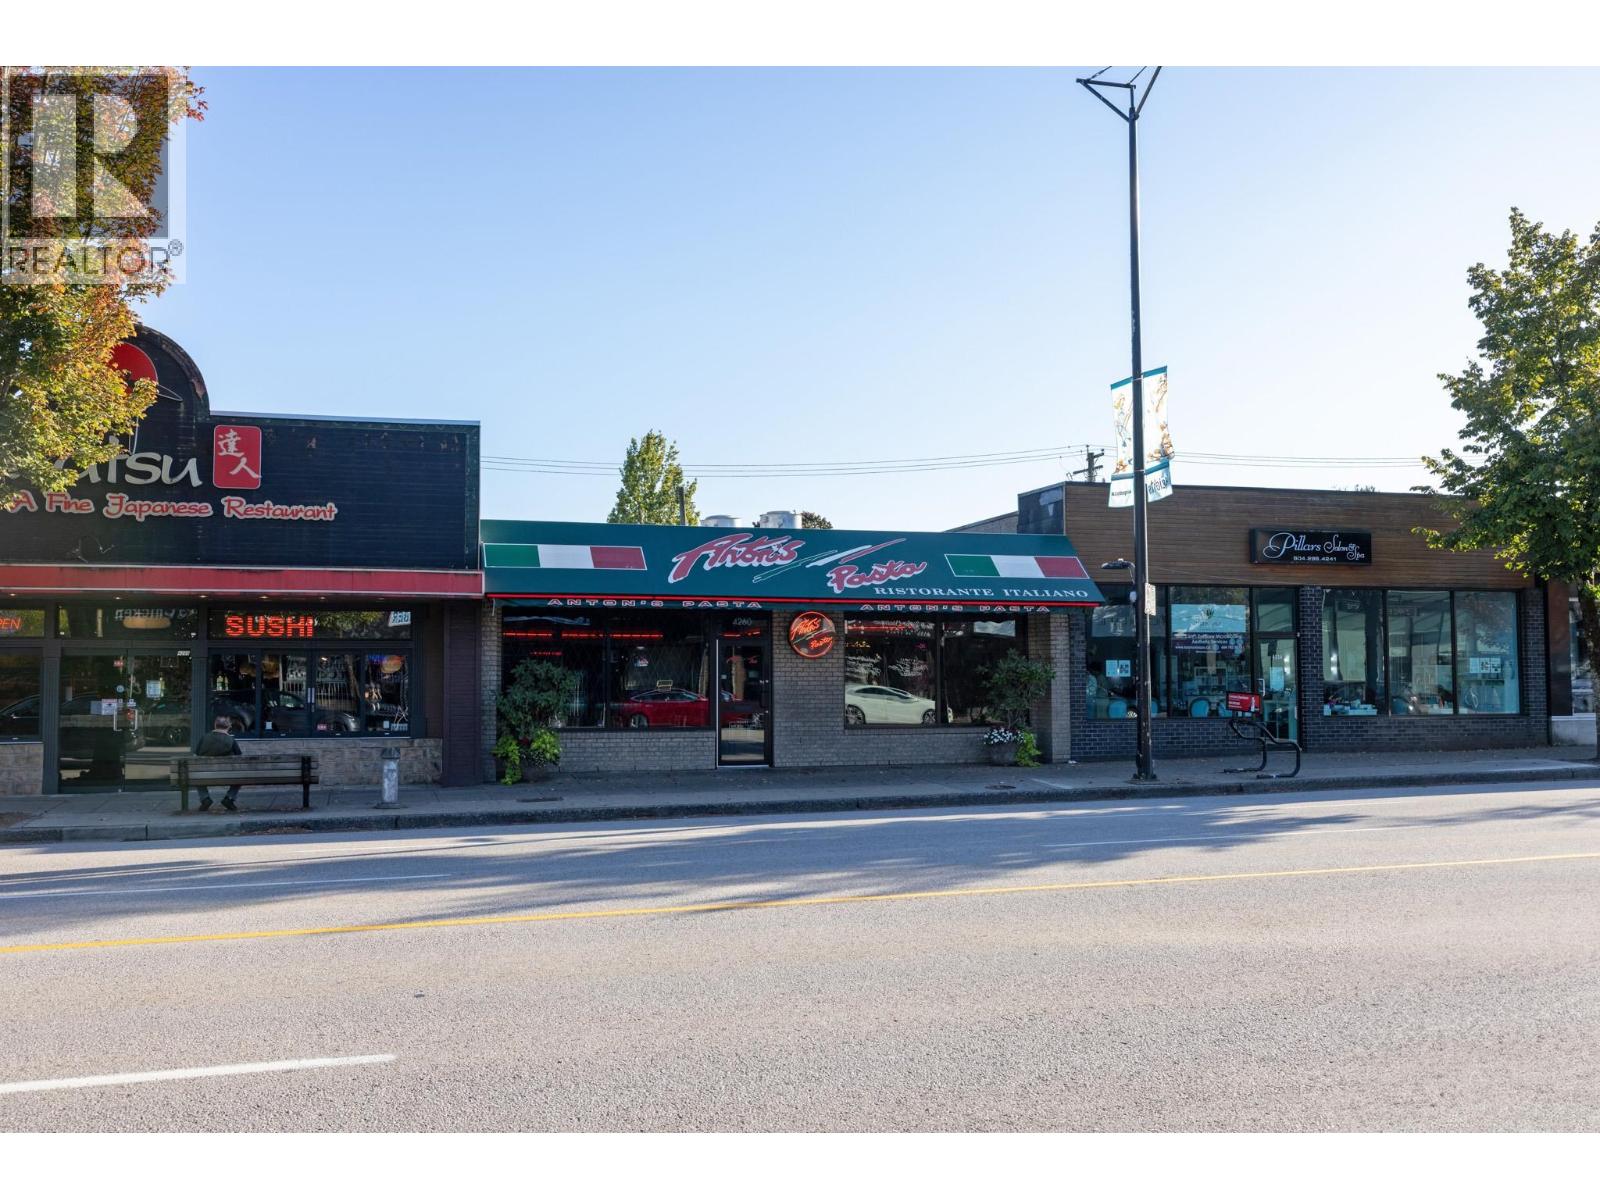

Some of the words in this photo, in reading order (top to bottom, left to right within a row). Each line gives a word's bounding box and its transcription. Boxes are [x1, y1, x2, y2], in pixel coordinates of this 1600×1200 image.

[217, 429, 262, 478] 達人
[45, 491, 95, 513] Fine
[103, 492, 213, 522] Japanese
[221, 496, 338, 521] Restaurant
[1262, 532, 1321, 558] Pillars
[668, 533, 806, 583] Anton's
[826, 560, 927, 593] Pasta
[547, 598, 664, 607] ANTON'S
[682, 600, 762, 609] PASTA
[874, 587, 995, 597] RISTORANTE
[1004, 588, 1089, 598] ITALIANO
[860, 603, 963, 612] ANTON'S
[979, 605, 1050, 613] PASTA
[225, 615, 314, 637] SUSHI
